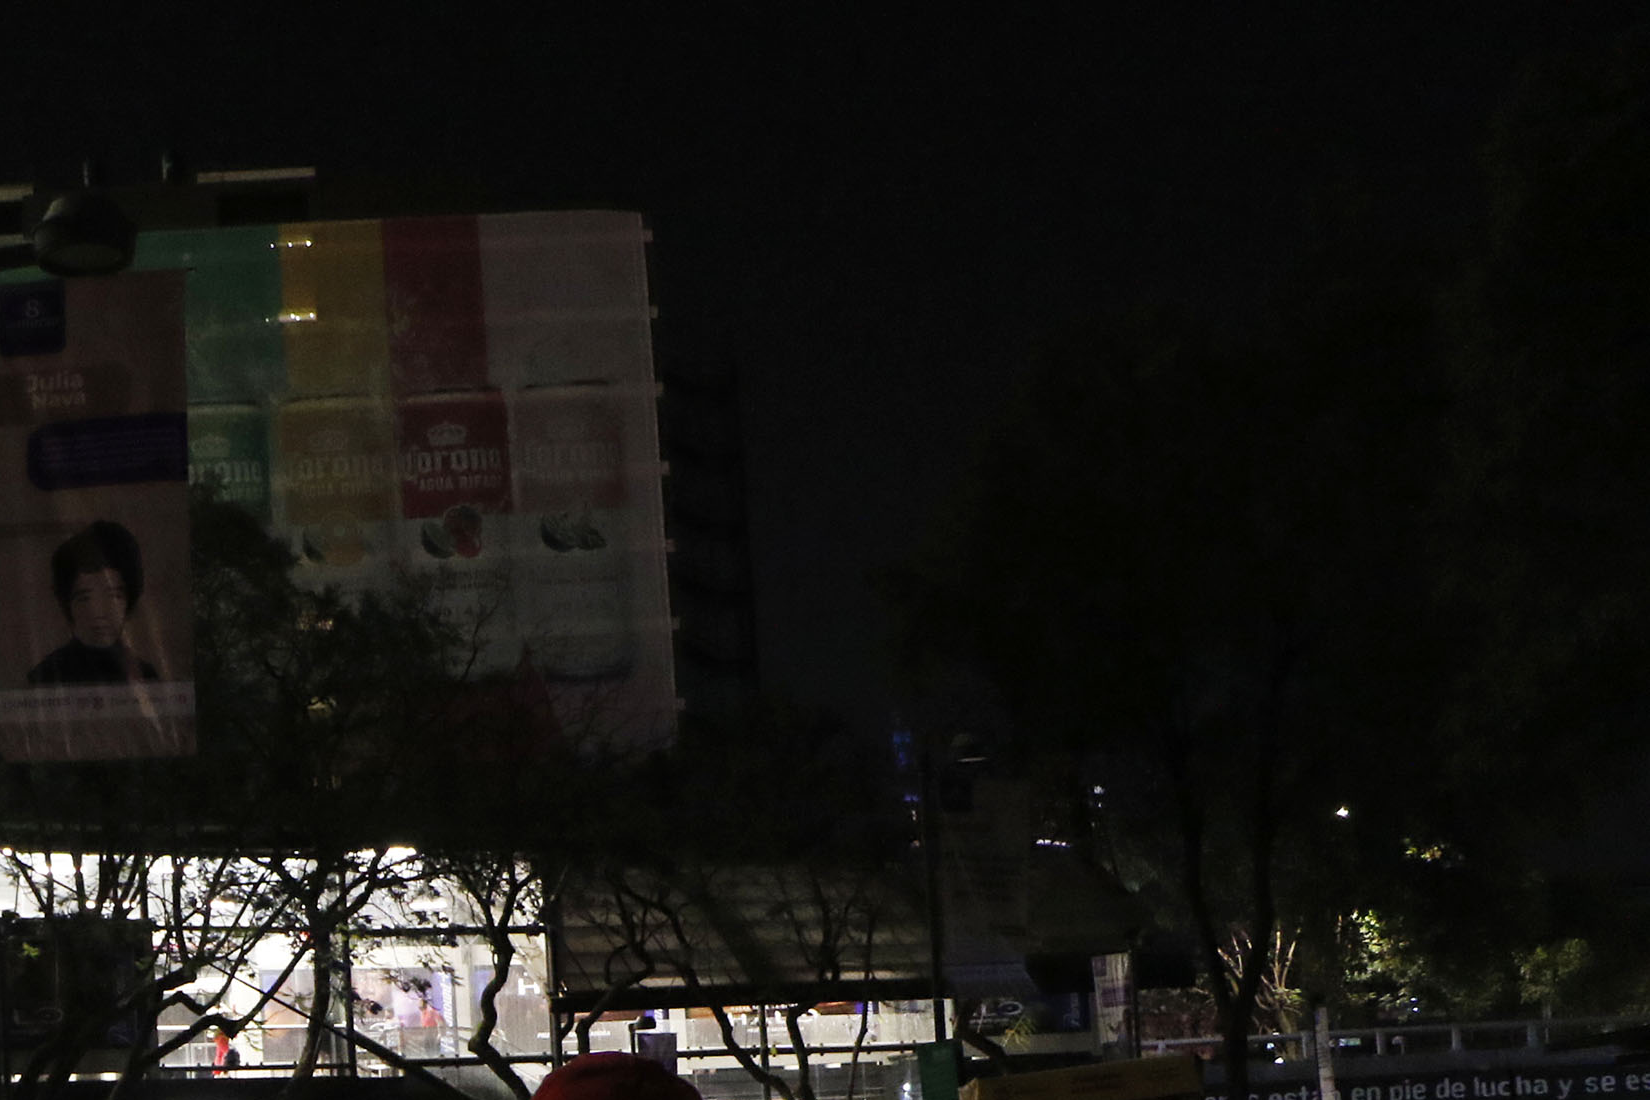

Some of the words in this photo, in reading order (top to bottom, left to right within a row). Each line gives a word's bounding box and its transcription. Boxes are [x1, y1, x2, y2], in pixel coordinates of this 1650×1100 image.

[27, 371, 85, 393] Julia
[1435, 1077, 1466, 1099] de
[1473, 1075, 1549, 1097] lucha
[1557, 1080, 1573, 1100] y
[1584, 1074, 1616, 1093] se
